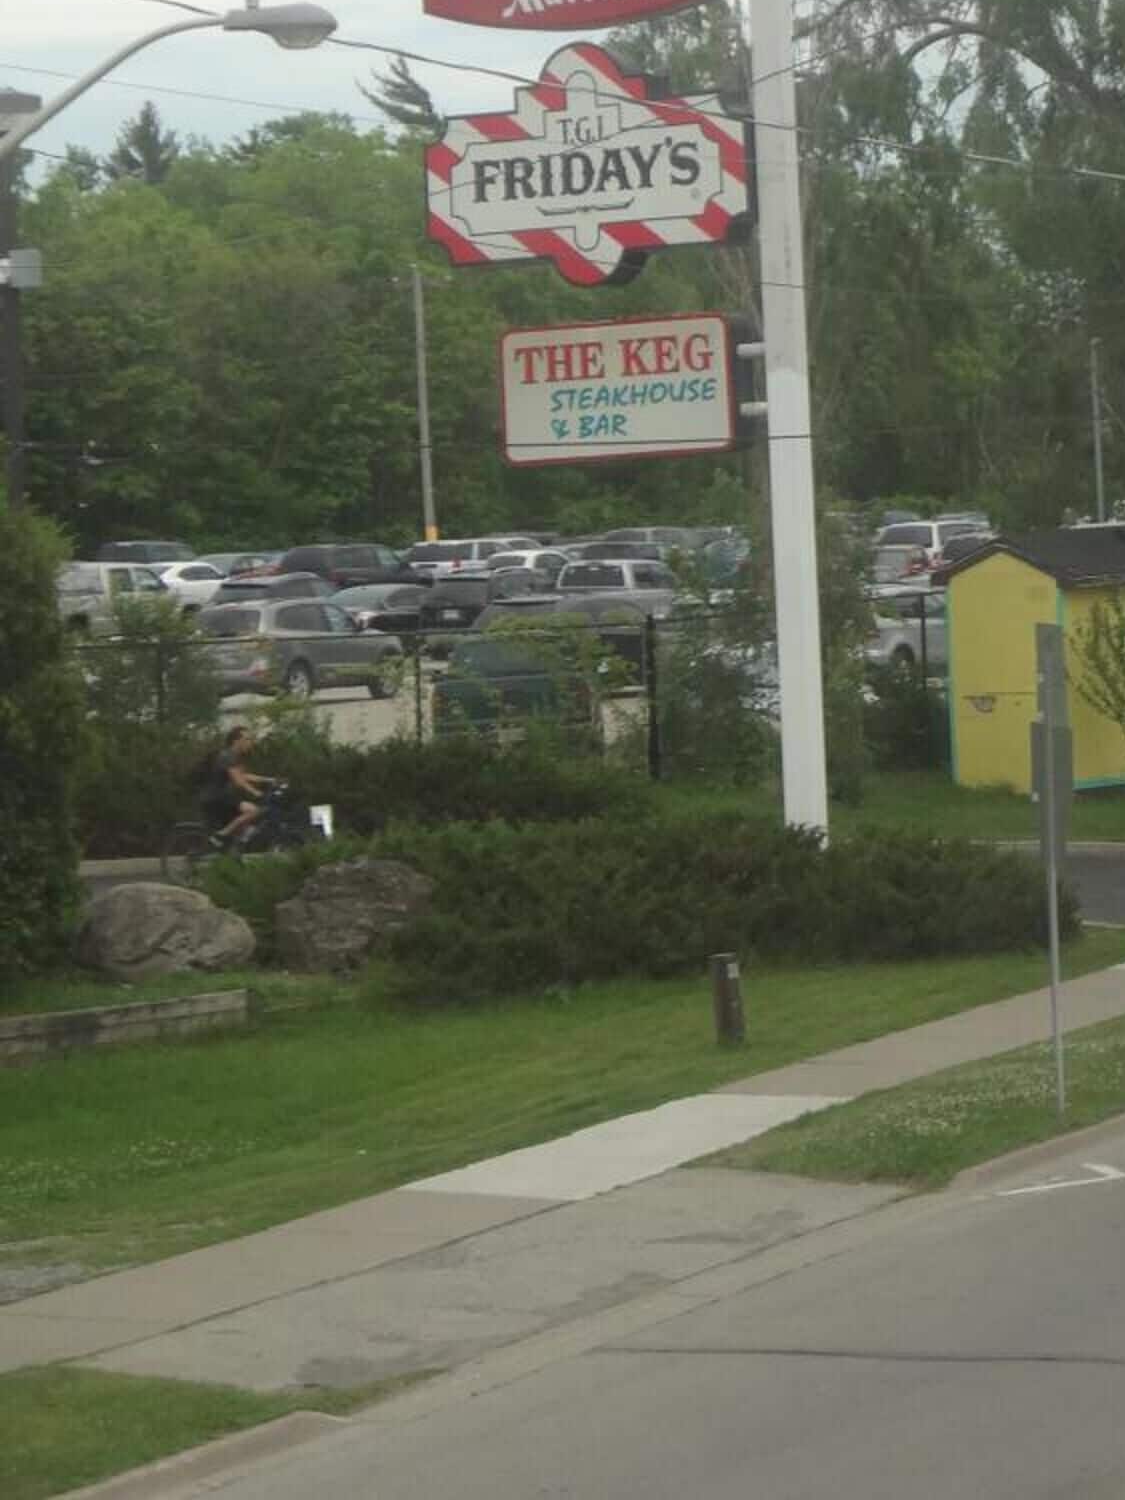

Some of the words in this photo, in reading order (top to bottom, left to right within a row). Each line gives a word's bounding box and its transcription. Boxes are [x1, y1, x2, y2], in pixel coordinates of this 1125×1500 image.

[472, 136, 700, 203] FRIDAY'S
[514, 341, 605, 384] THE
[618, 333, 713, 377] KEG
[550, 378, 717, 411] STEAKHOUSE
[551, 419, 570, 439] &
[577, 414, 628, 439] BAR
